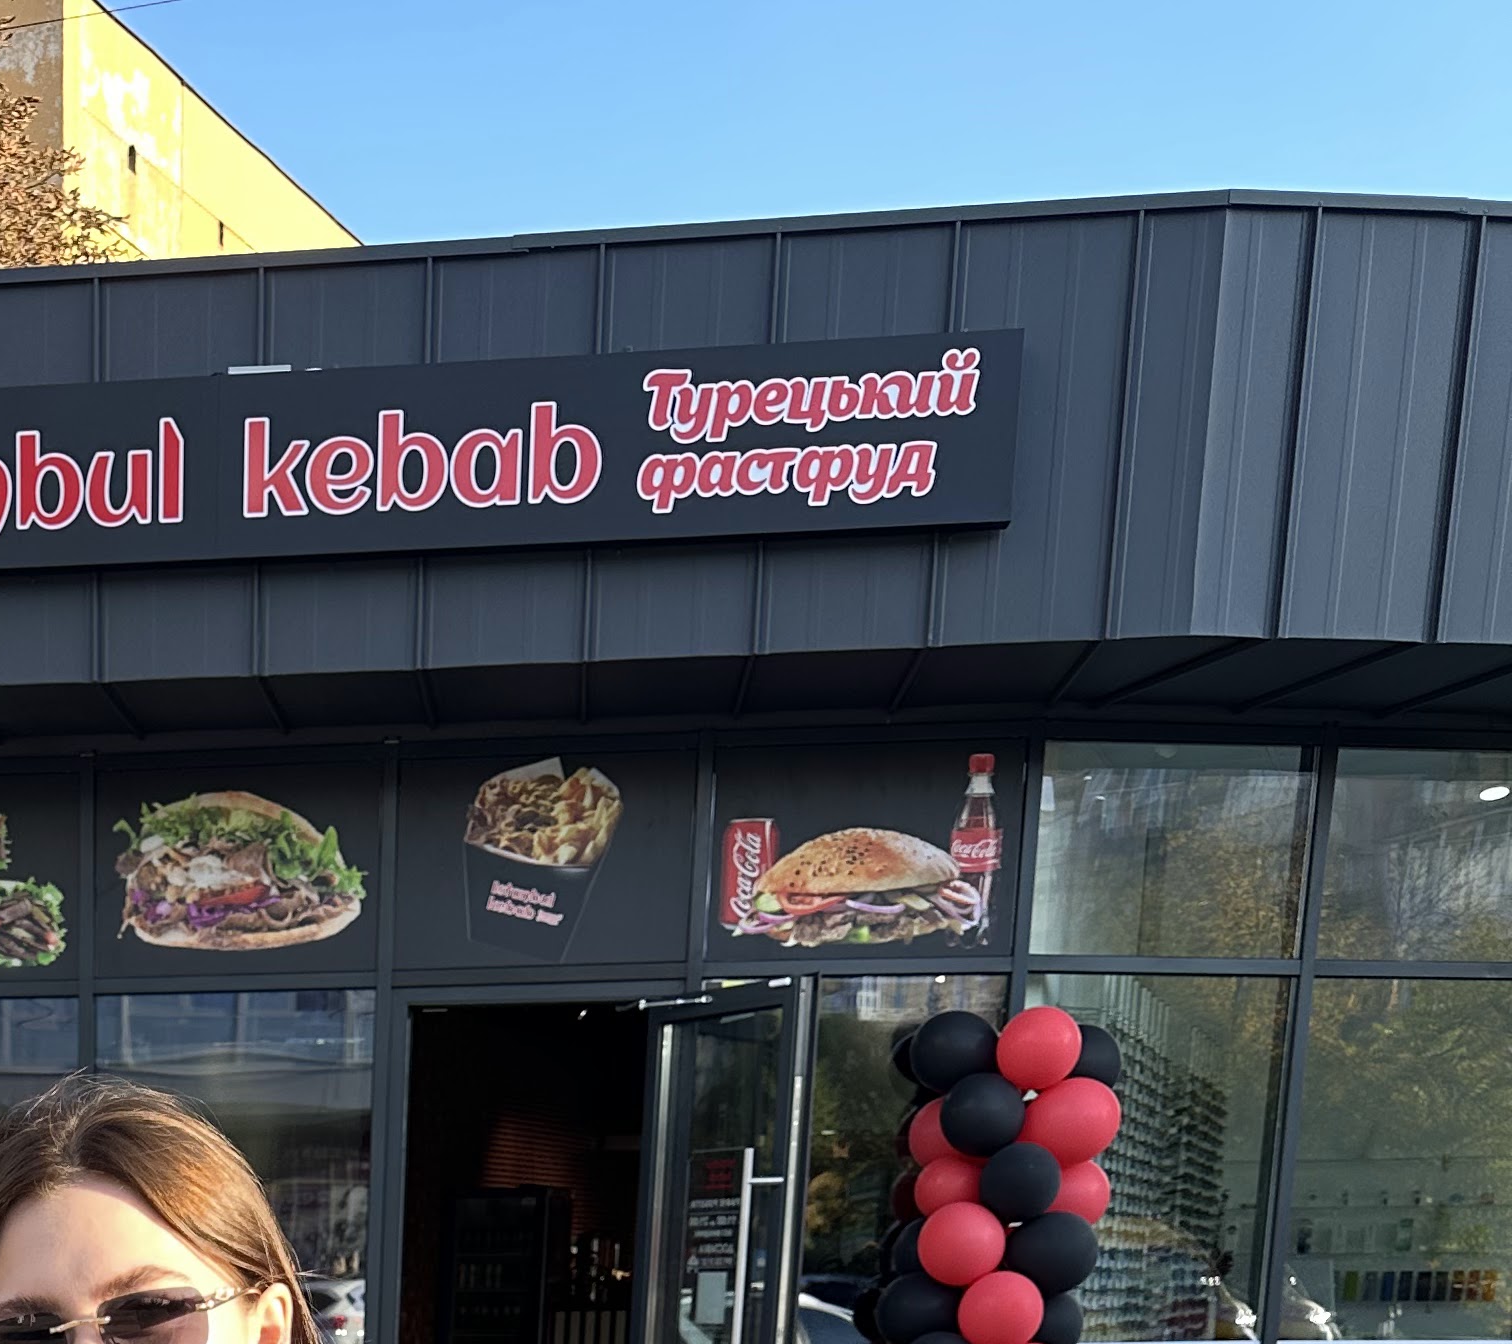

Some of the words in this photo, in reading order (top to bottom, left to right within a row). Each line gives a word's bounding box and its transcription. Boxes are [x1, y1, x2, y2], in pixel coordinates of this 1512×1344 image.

[643, 347, 980, 444] Турецький
[243, 401, 602, 518] kebab
[637, 440, 937, 514] фастфуд
